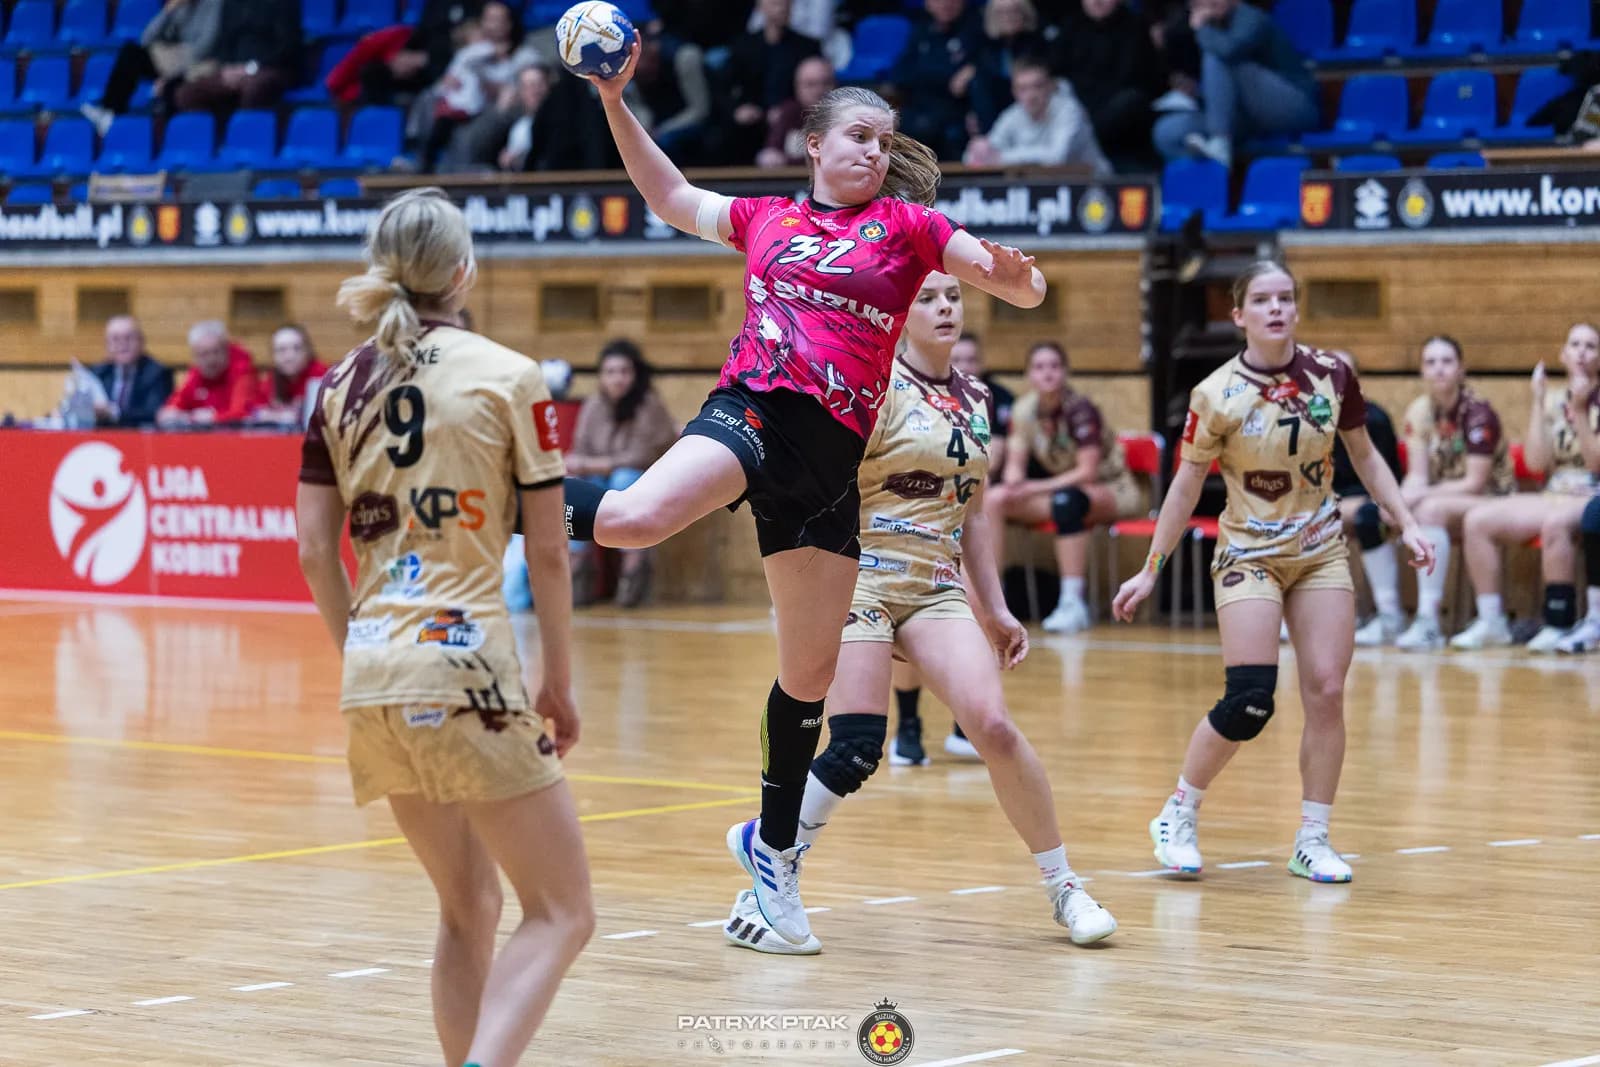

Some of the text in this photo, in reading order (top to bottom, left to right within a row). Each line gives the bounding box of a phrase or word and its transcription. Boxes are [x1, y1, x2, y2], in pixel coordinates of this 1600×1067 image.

[778, 234, 857, 275] 32
[773, 279, 894, 335] SUZUKI
[384, 384, 426, 469] 9
[711, 408, 743, 426] Targi
[1277, 415, 1300, 456] 7
[742, 424, 766, 461] Kielce
[946, 428, 969, 467] 4
[148, 466, 209, 500] LIGA
[150, 504, 299, 541] CENTRALNA
[565, 504, 575, 537] SELECT
[151, 542, 243, 577] KOBIET
